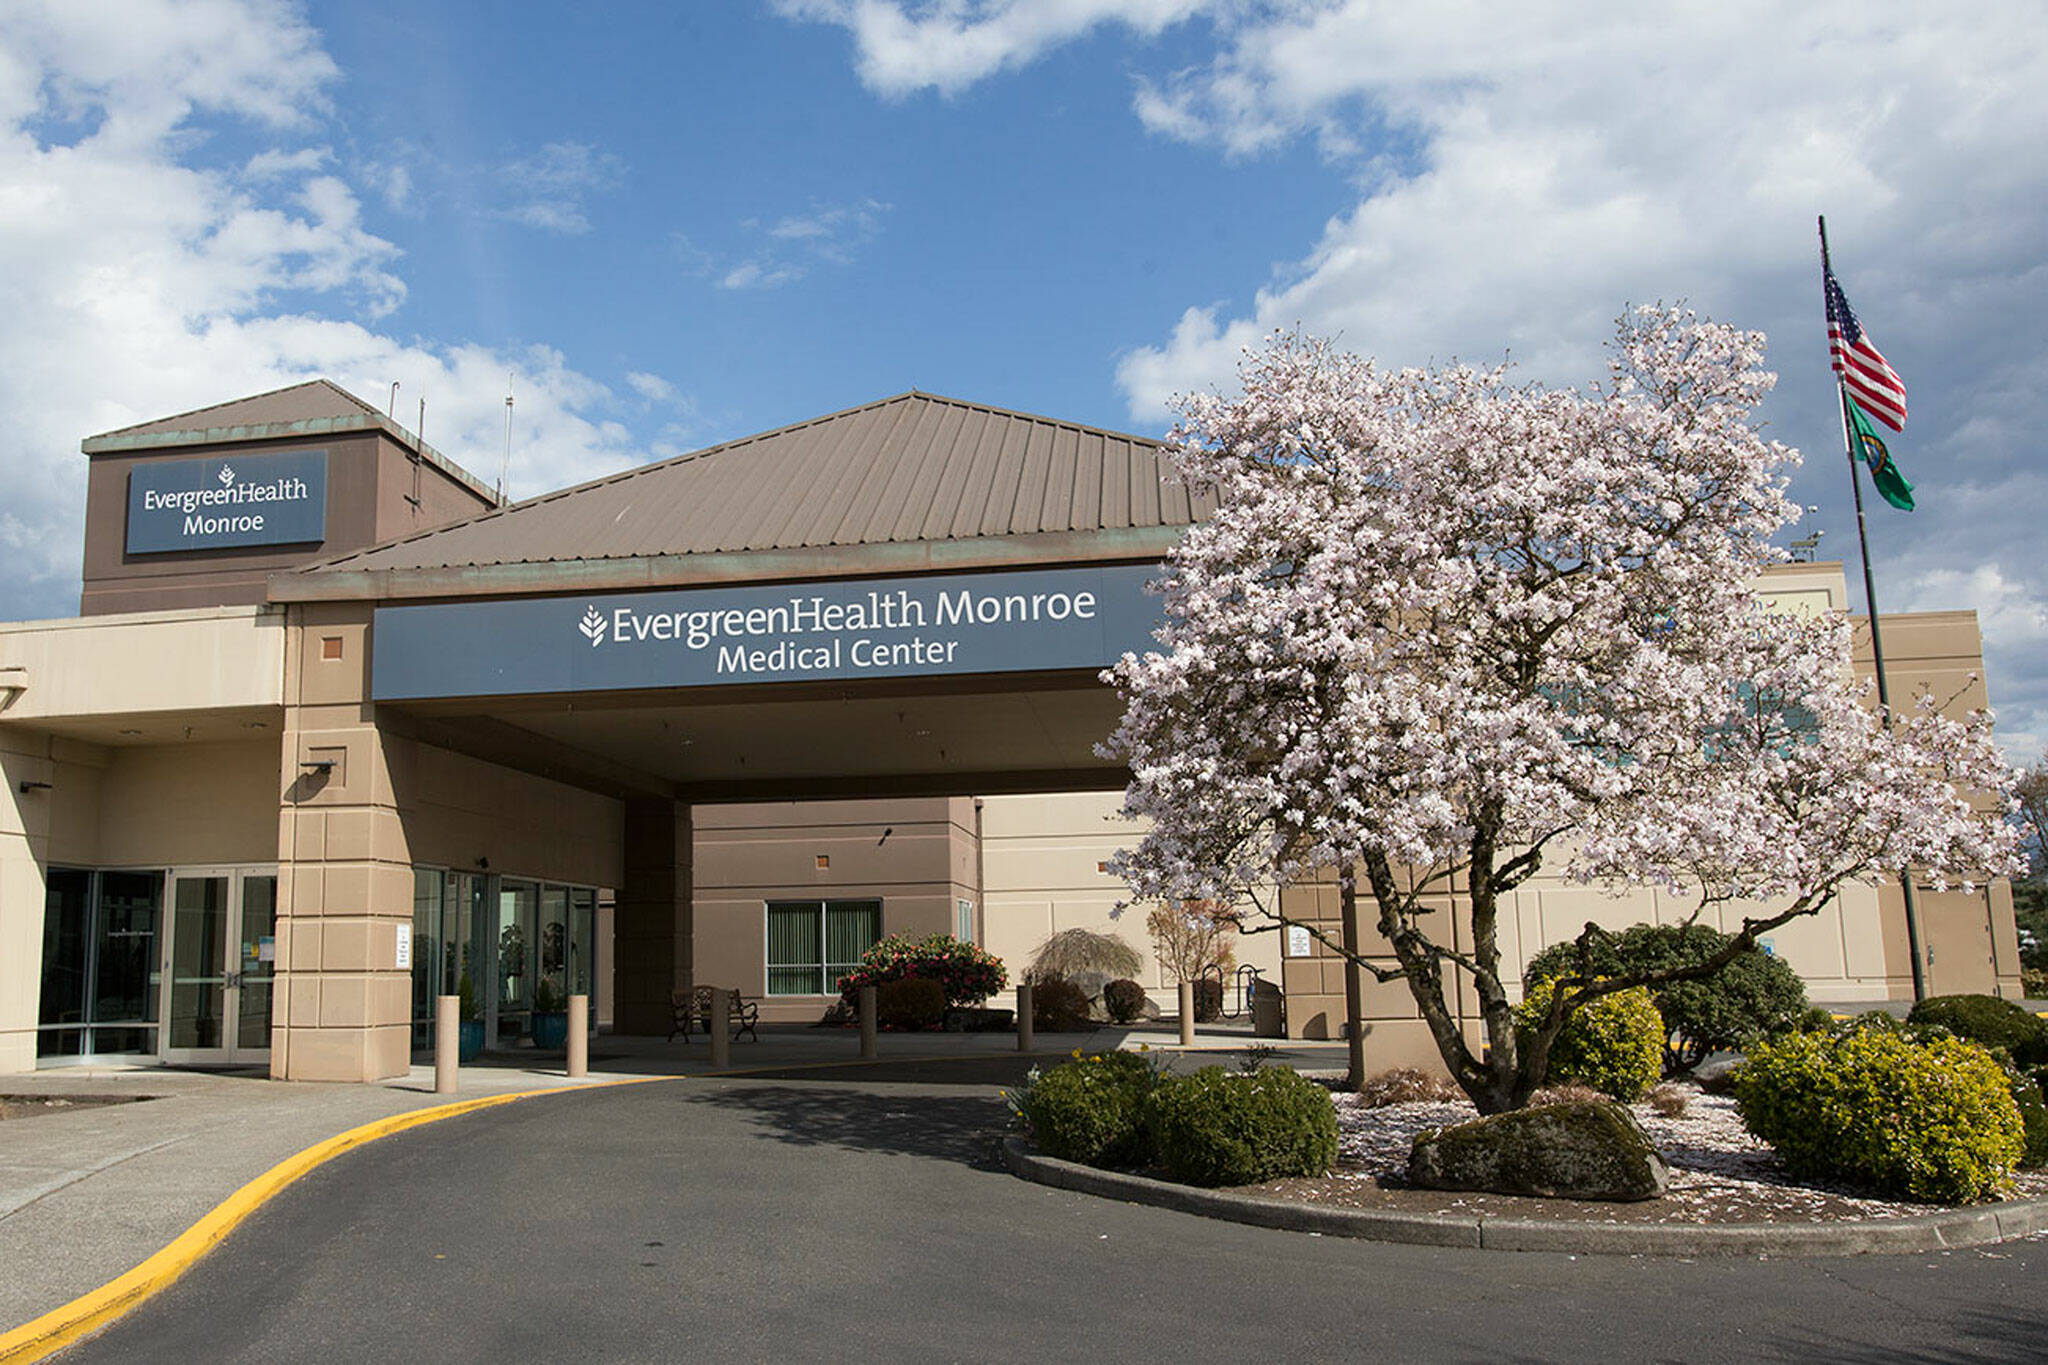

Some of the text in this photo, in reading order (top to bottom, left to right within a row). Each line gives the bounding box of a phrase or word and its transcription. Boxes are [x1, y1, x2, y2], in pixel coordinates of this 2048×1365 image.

[144, 478, 307, 513] EvergreenHealth
[183, 515, 264, 536] Monroe
[613, 591, 1096, 649] EvergreenHealth Monroe
[717, 638, 959, 674] Medical Center
